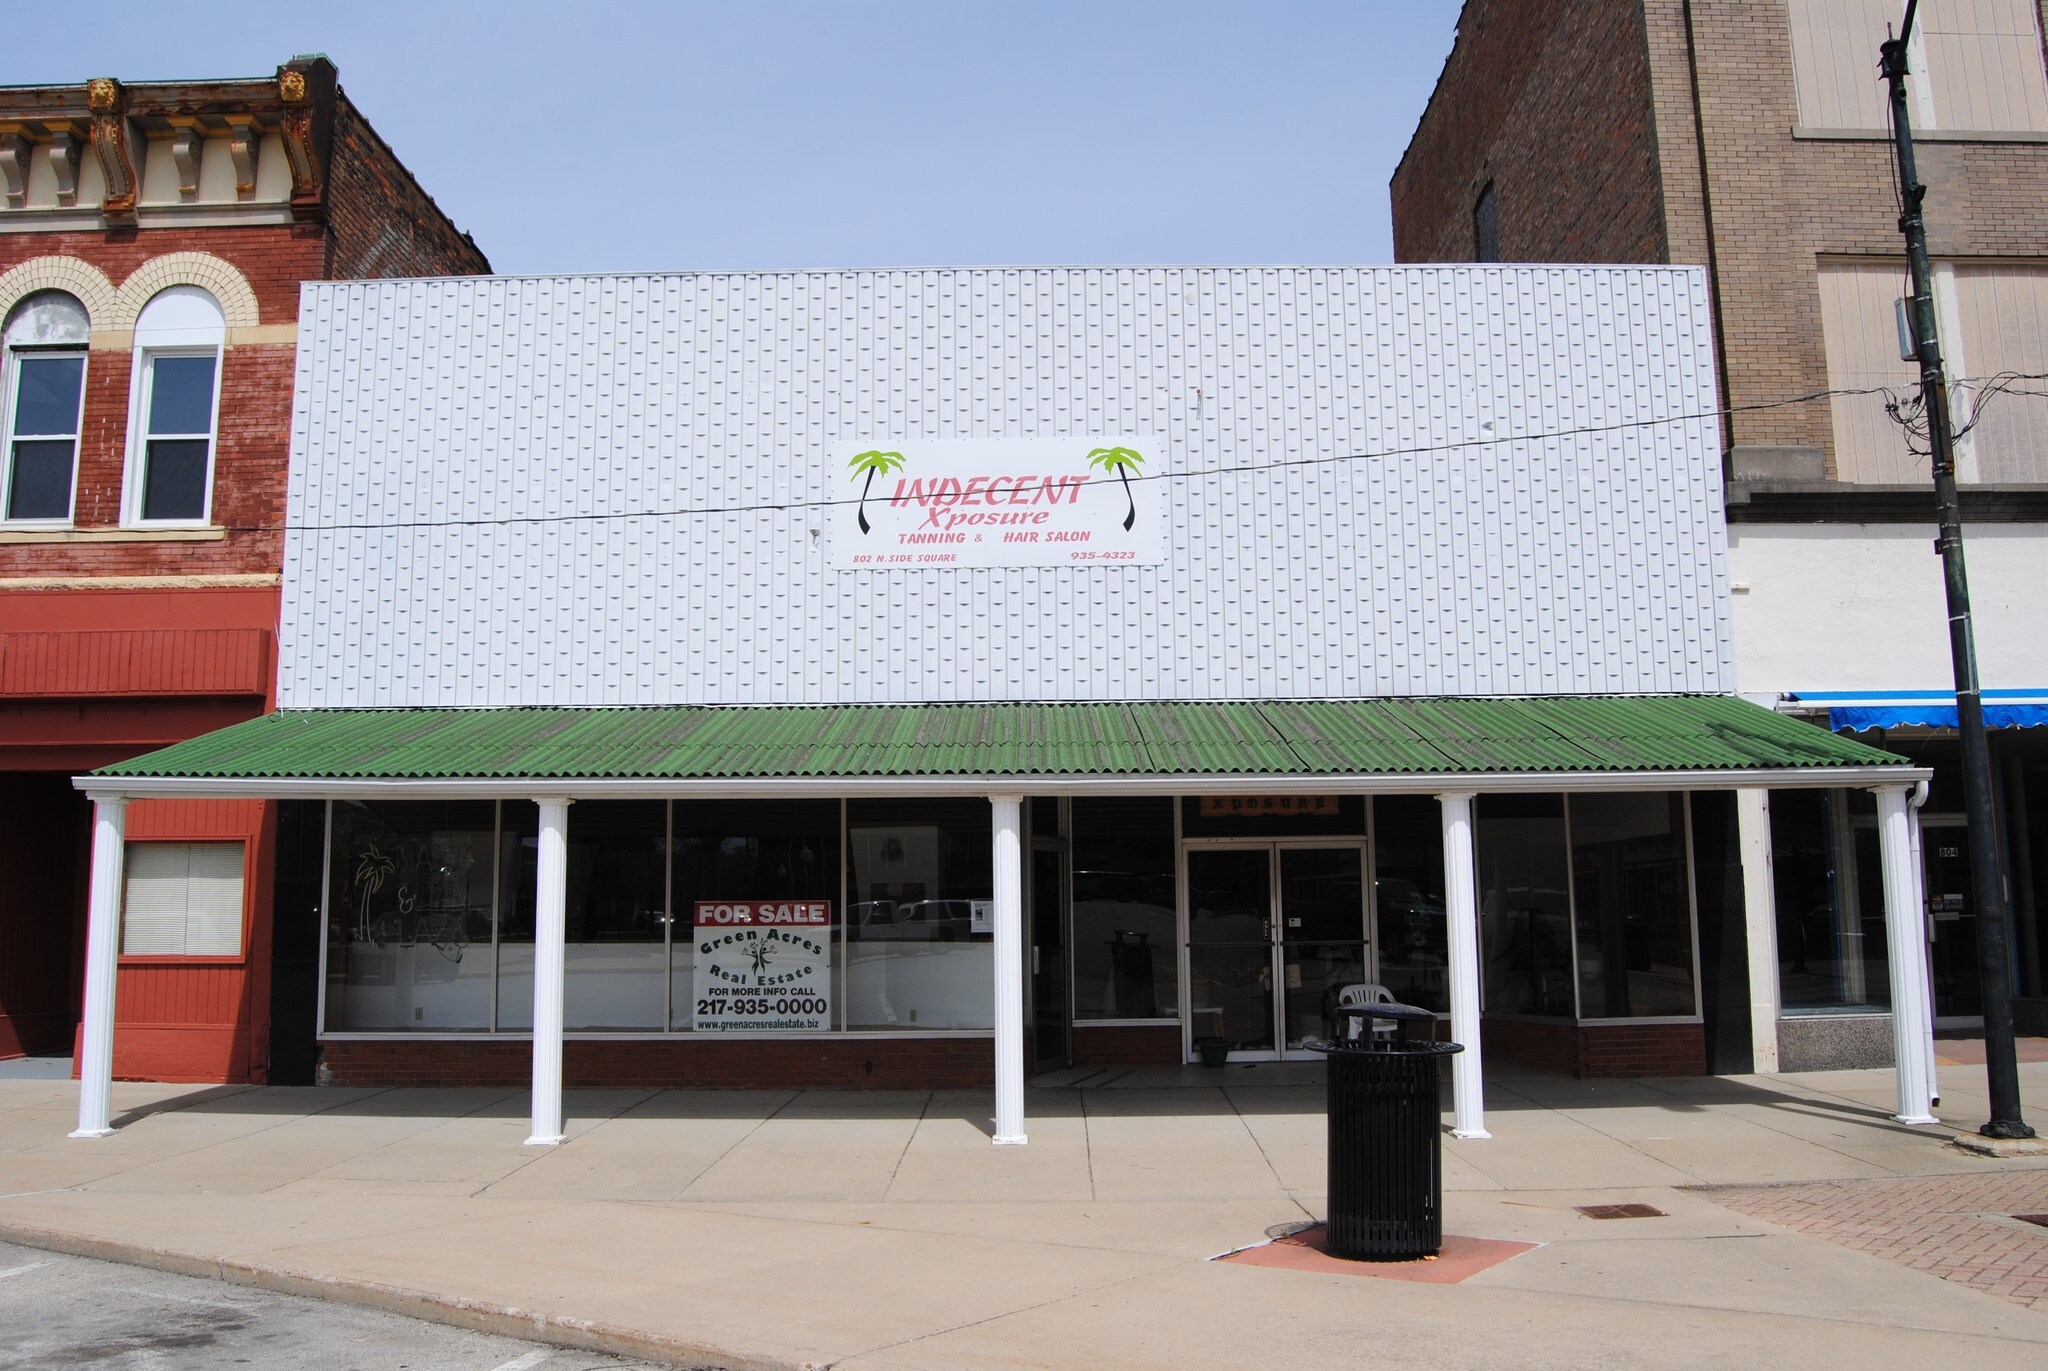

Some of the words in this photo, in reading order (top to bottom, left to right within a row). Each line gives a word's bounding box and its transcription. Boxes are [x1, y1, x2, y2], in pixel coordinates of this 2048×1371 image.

[889, 475, 1091, 507] INDECENT
[918, 507, 1050, 531] Xposure
[899, 533, 966, 544] TANNING
[974, 533, 983, 543] &
[1003, 531, 1039, 543] HAIR
[1045, 531, 1091, 542] SALON
[853, 555, 873, 563] 802
[917, 553, 958, 562] SQUARE
[1070, 551, 1136, 560] 935-4323
[1940, 848, 1958, 857] 804
[699, 905, 751, 924] FOR
[758, 904, 825, 923] SALE
[700, 930, 757, 955] Green
[767, 928, 822, 955] Acres
[709, 964, 747, 985] Real
[757, 965, 813, 986] Estate
[708, 988, 729, 996] FOR
[731, 987, 761, 996] MORE
[763, 987, 787, 996] INFO
[790, 987, 816, 996] CALL
[697, 998, 827, 1015] 217-935-0000
[697, 1018, 819, 1031] www.greenacresrealestate.biz
